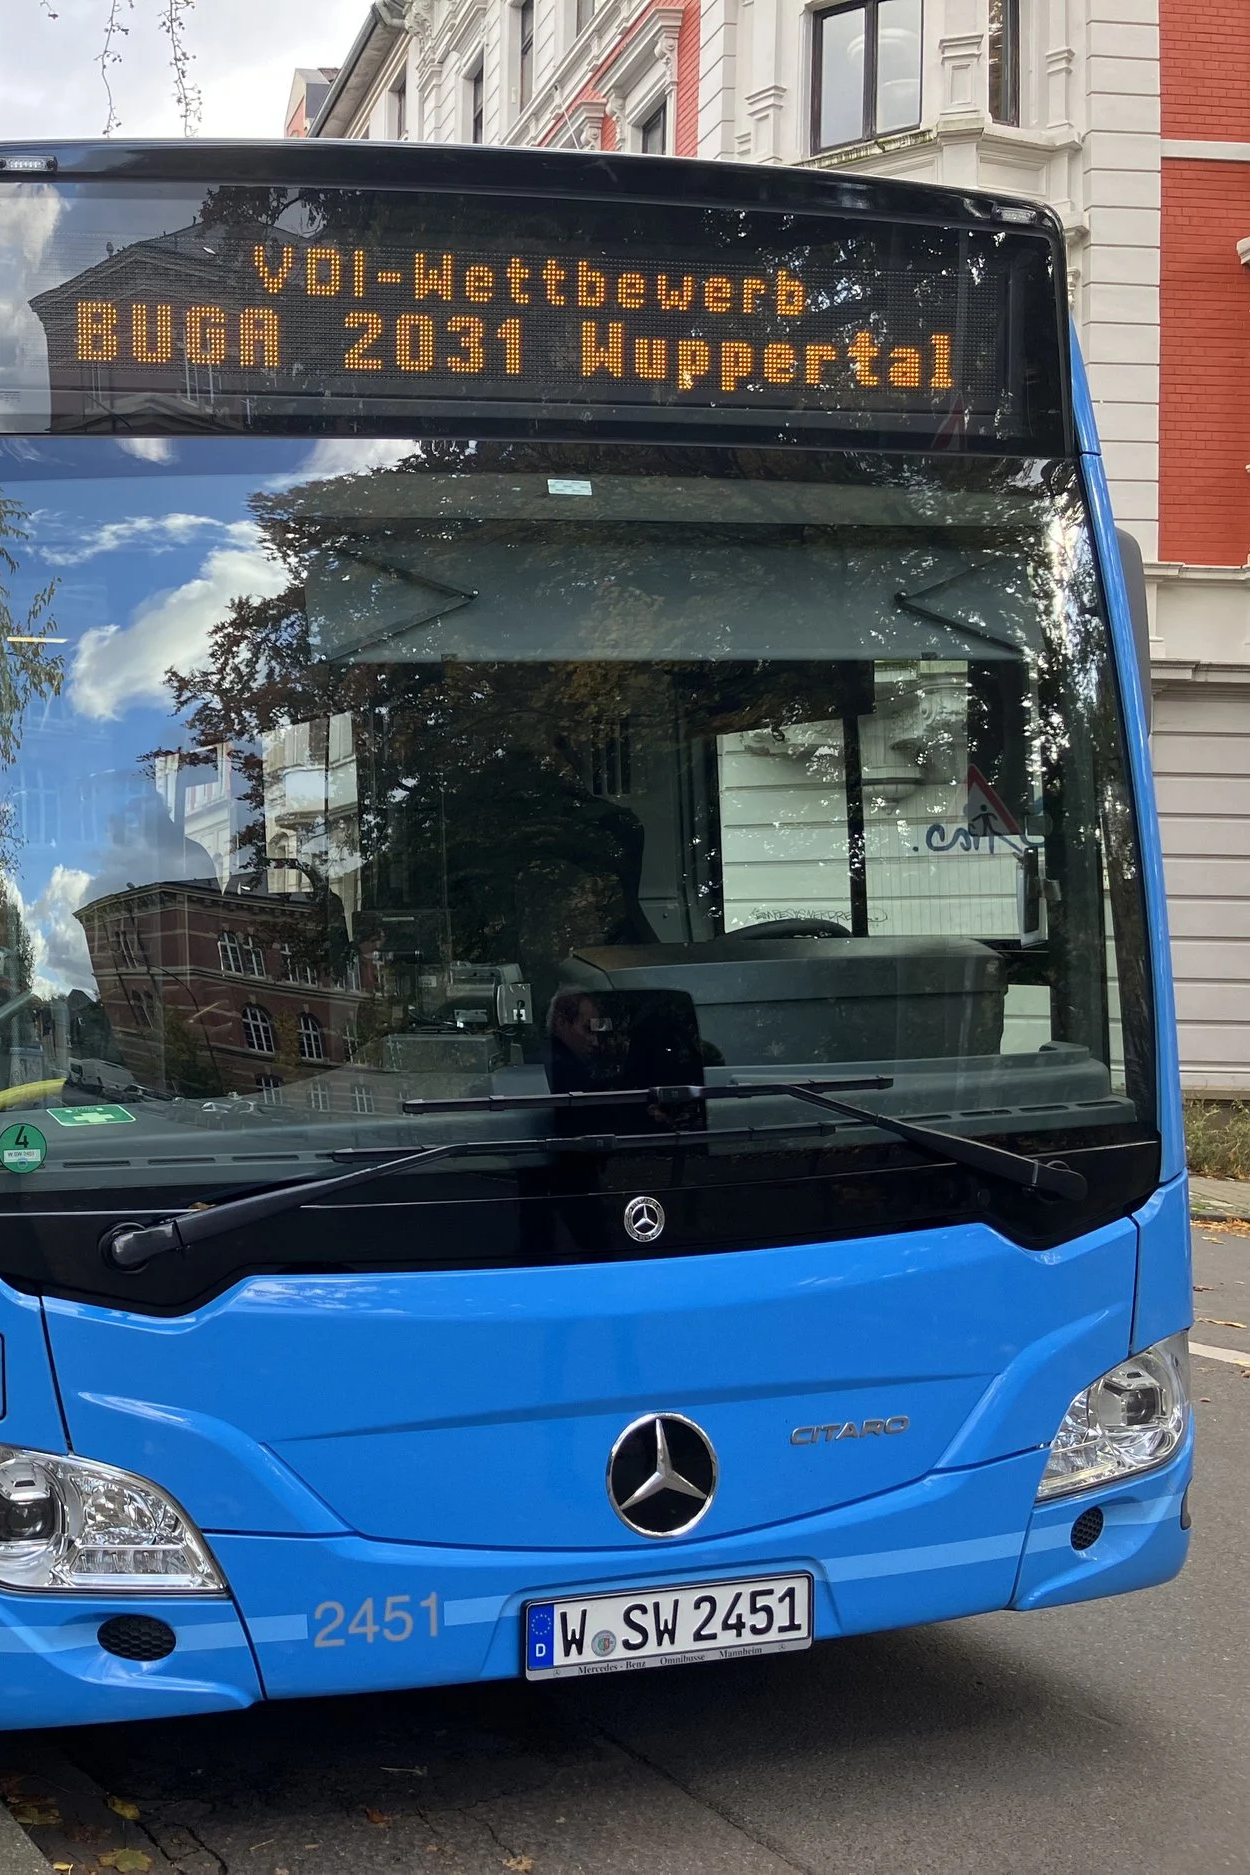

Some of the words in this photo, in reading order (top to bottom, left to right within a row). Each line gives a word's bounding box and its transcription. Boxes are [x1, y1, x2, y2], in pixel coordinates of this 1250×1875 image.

[253, 245, 806, 316] VDI-Wettbewerb
[76, 302, 279, 367] BUGA
[344, 312, 521, 374] 2031
[581, 320, 953, 391] Wuppertal
[15, 1126, 29, 1148] 4
[790, 1415, 911, 1445] CITARO
[314, 1592, 438, 1648] 2451
[560, 1608, 587, 1657] W
[622, 1599, 679, 1650] SW
[693, 1587, 801, 1642] 2451
[535, 1643, 546, 1657] D
[660, 1653, 705, 1665] Omnibusse
[719, 1646, 762, 1659] Mannheim
